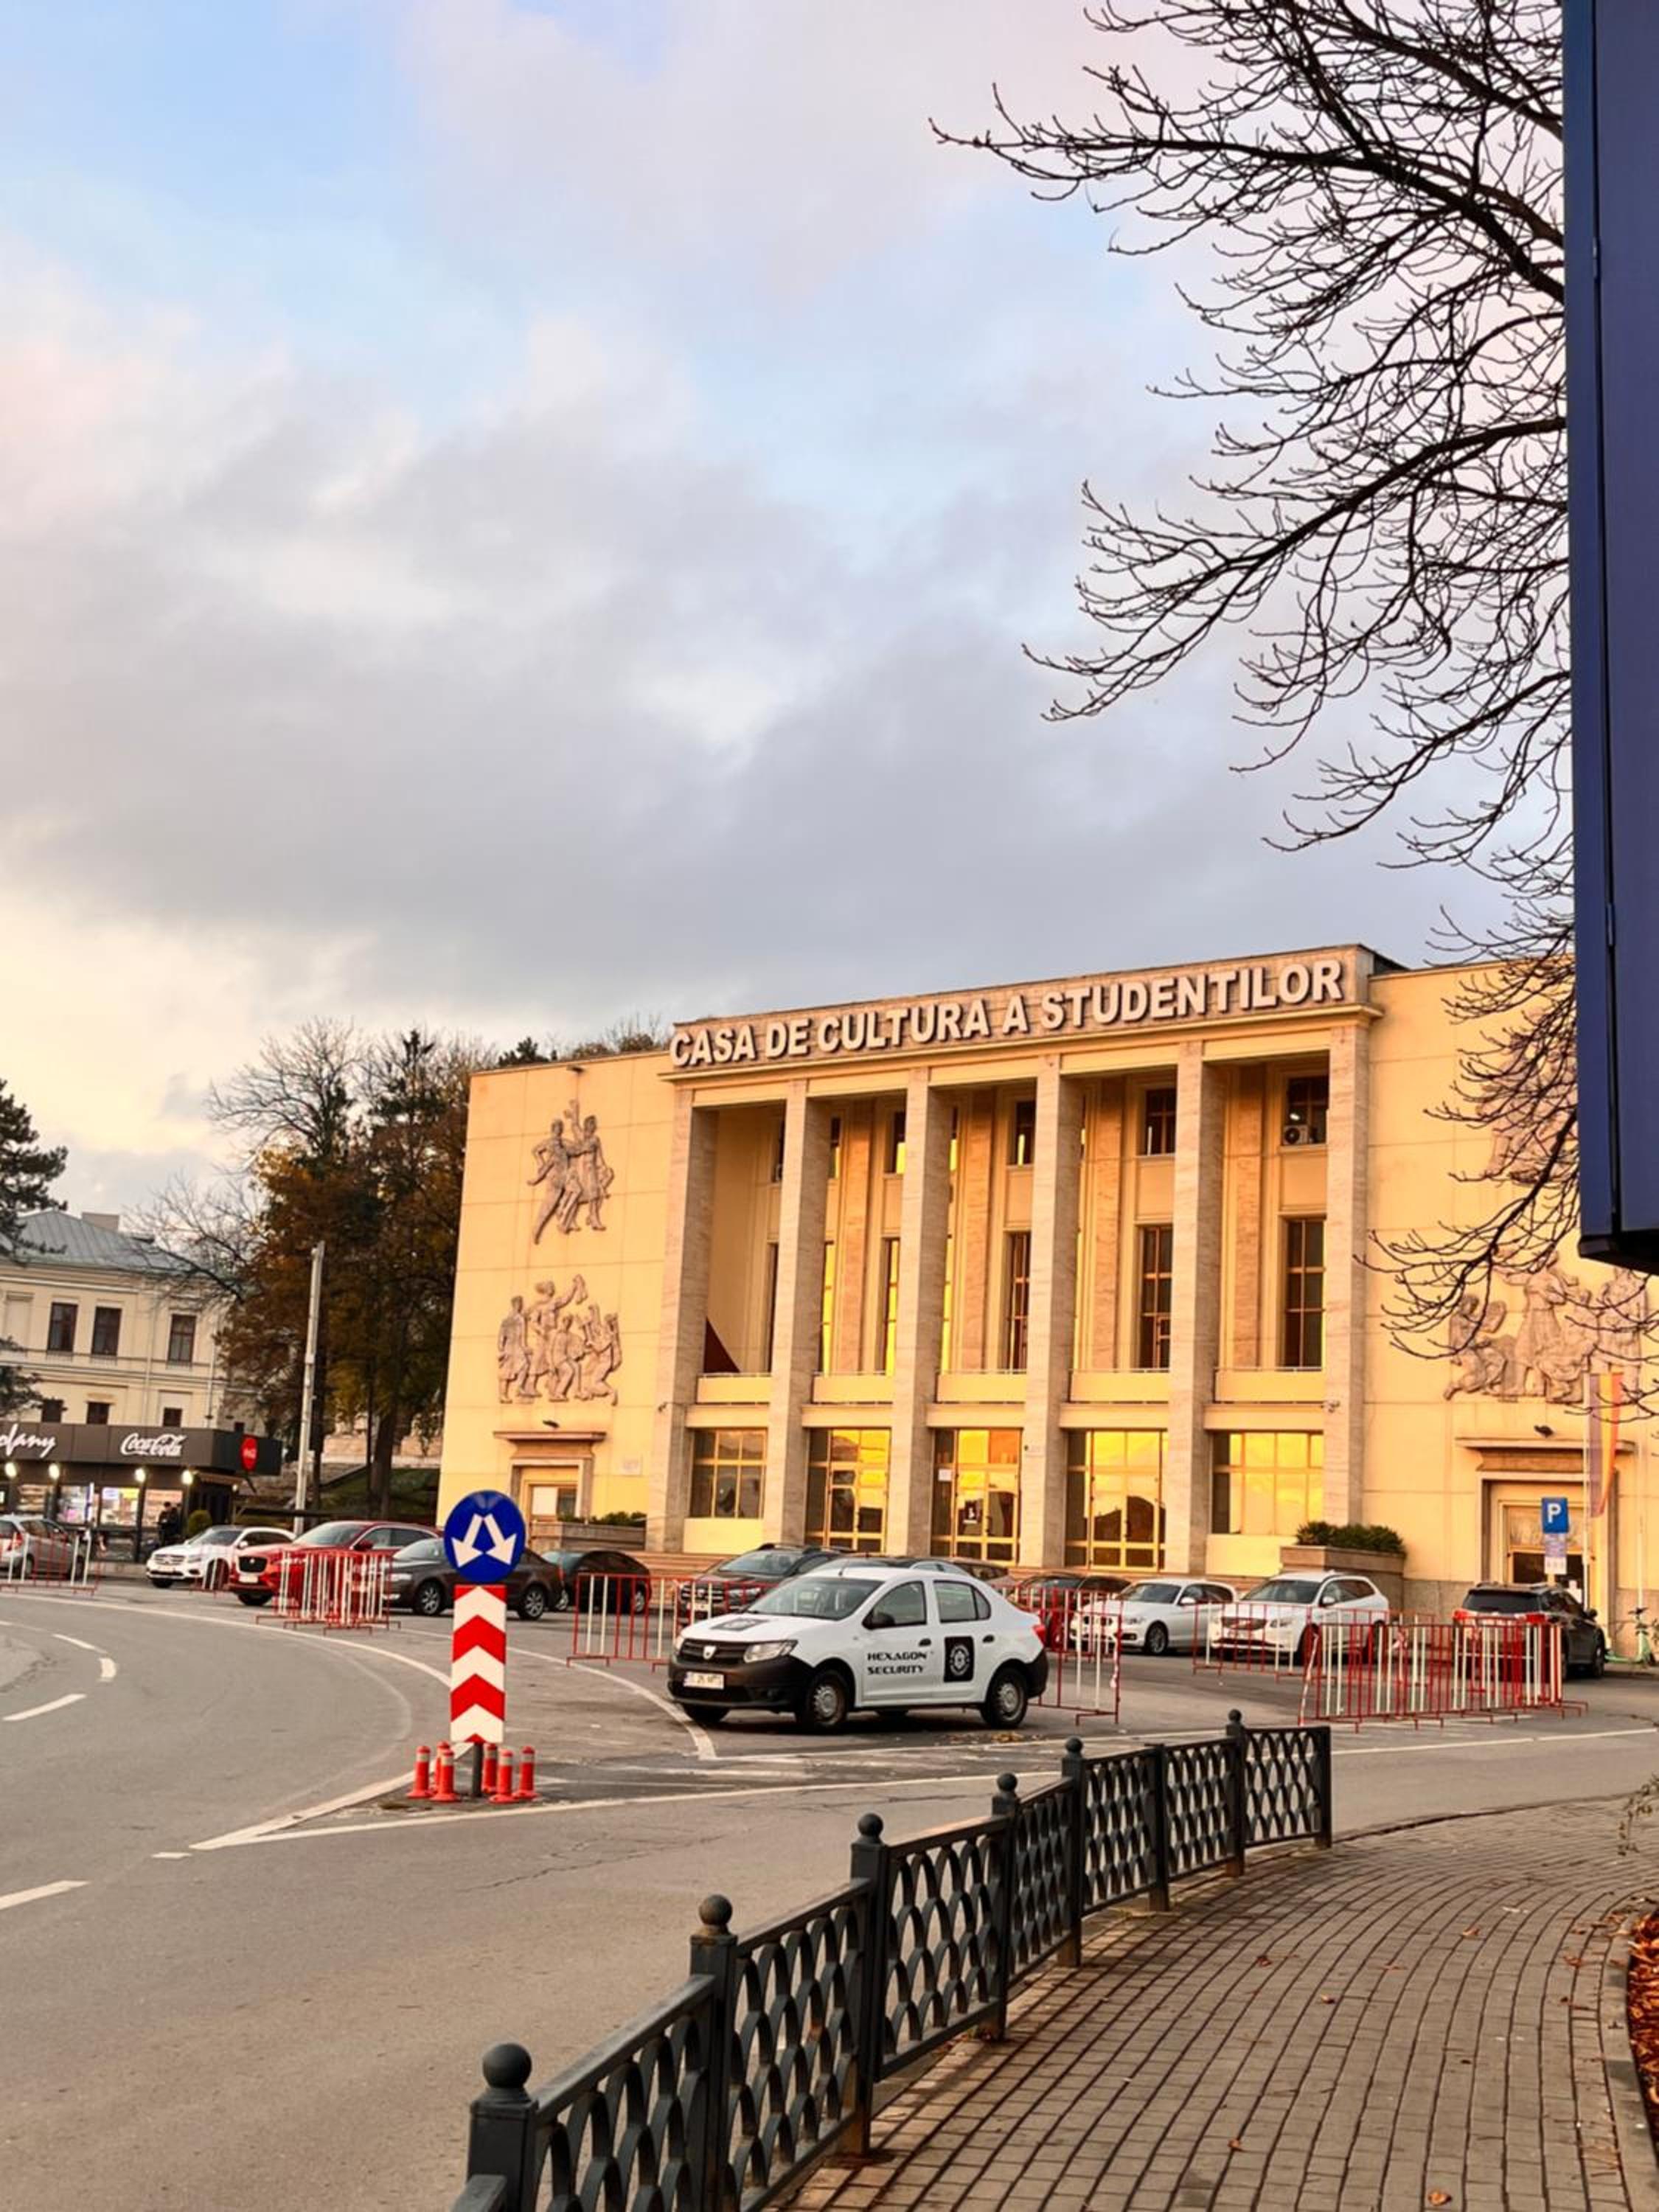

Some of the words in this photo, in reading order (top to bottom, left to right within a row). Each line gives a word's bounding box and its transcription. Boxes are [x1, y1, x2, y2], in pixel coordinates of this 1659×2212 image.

[669, 1025, 757, 1066] CASA
[765, 1019, 810, 1060] DE
[817, 999, 990, 1053] CULTURA
[1002, 995, 1029, 1034] A
[1040, 959, 1343, 1029] STUDENTILOR
[1547, 1503, 1562, 1524] P
[867, 1651, 928, 1661] HEXAGON
[867, 1664, 924, 1675] SECURITY
